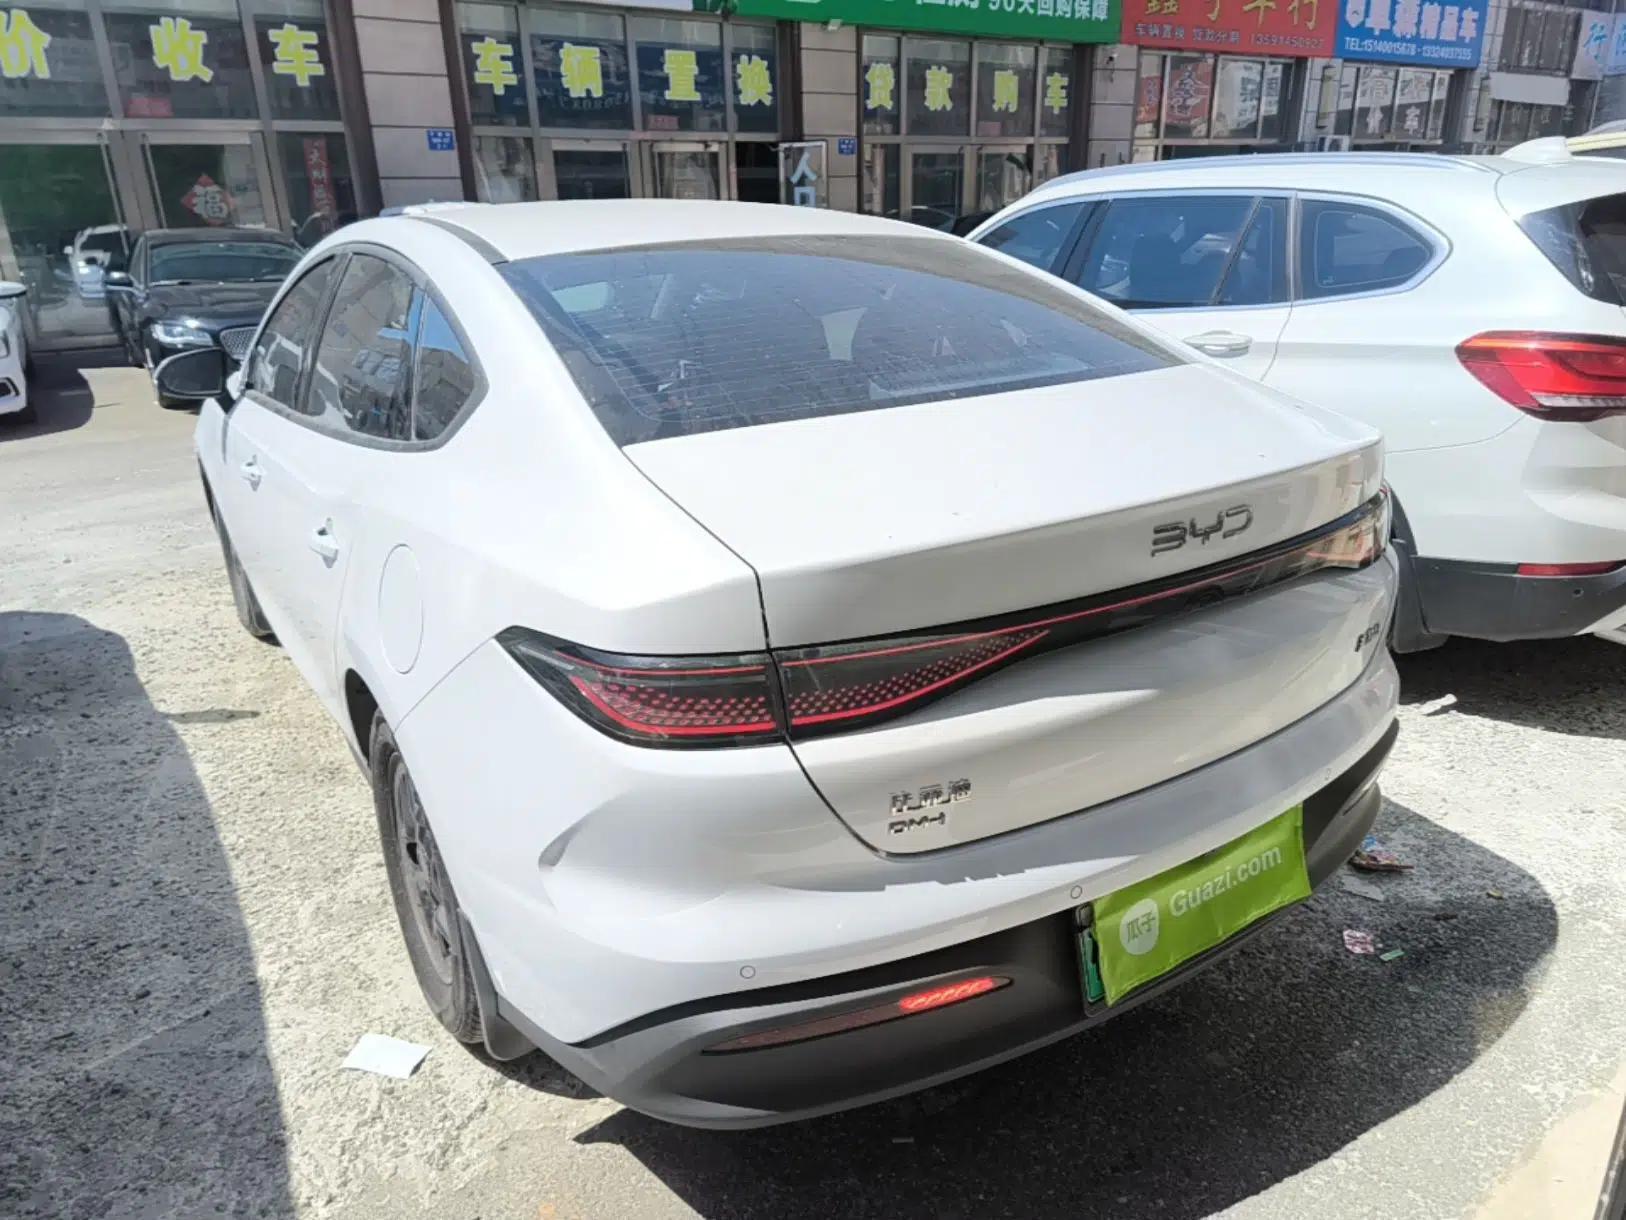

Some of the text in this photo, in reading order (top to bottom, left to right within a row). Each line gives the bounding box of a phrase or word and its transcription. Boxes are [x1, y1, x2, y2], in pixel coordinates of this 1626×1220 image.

[471, 37, 773, 107] 车辆置换
[865, 62, 1070, 115] 贷款购车
[192, 183, 229, 219] 福
[1151, 503, 1254, 557] BYD
[1168, 845, 1283, 918] Guazi.com
[1125, 911, 1157, 944] 瓜子
